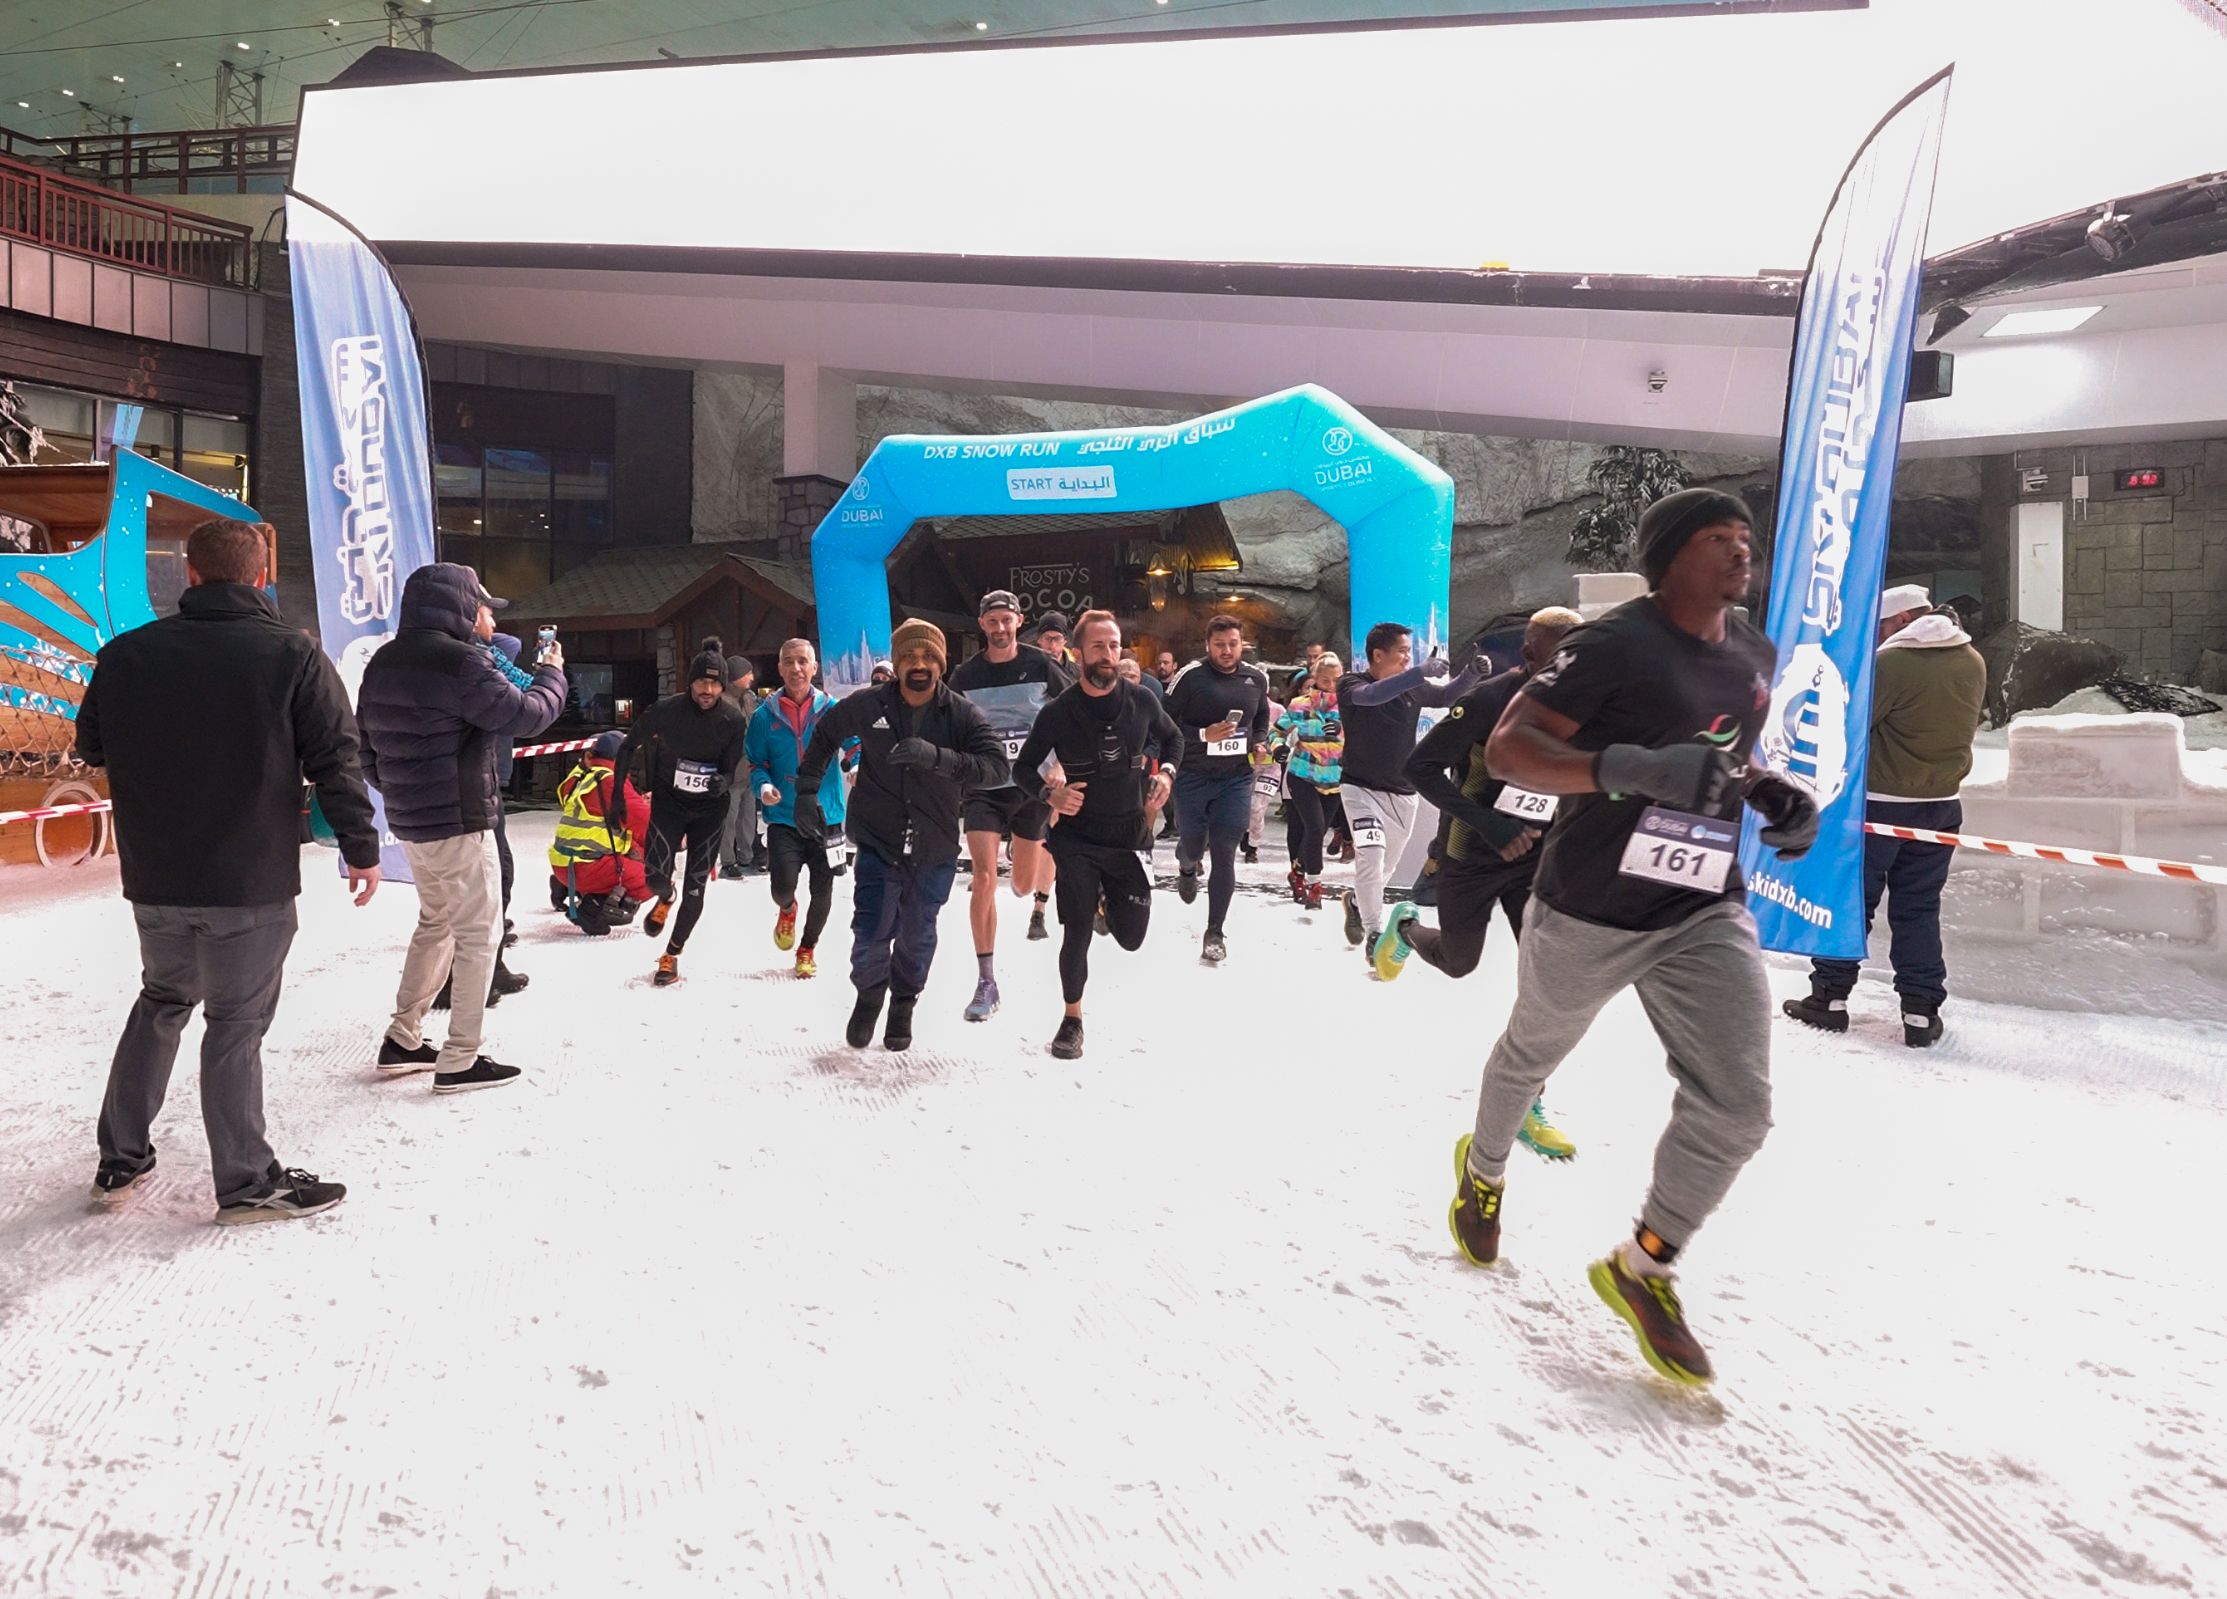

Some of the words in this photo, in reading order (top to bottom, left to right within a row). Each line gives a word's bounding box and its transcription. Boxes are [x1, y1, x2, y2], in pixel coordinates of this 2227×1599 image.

[923, 445, 958, 459] DXB
[961, 443, 1018, 459] SNOW
[1019, 442, 1060, 457] RUN
[1314, 460, 1372, 485] DUBAI
[1011, 478, 1053, 490] START
[1058, 476, 1111, 492] البداية
[841, 508, 883, 522] DUBAI
[1008, 562, 1090, 592] FROSTY'S
[1017, 588, 1094, 613] OCOA
[1216, 741, 1239, 752] 160
[1514, 794, 1548, 813] 128
[1366, 830, 1381, 841] 49
[1650, 843, 1708, 876] 161
